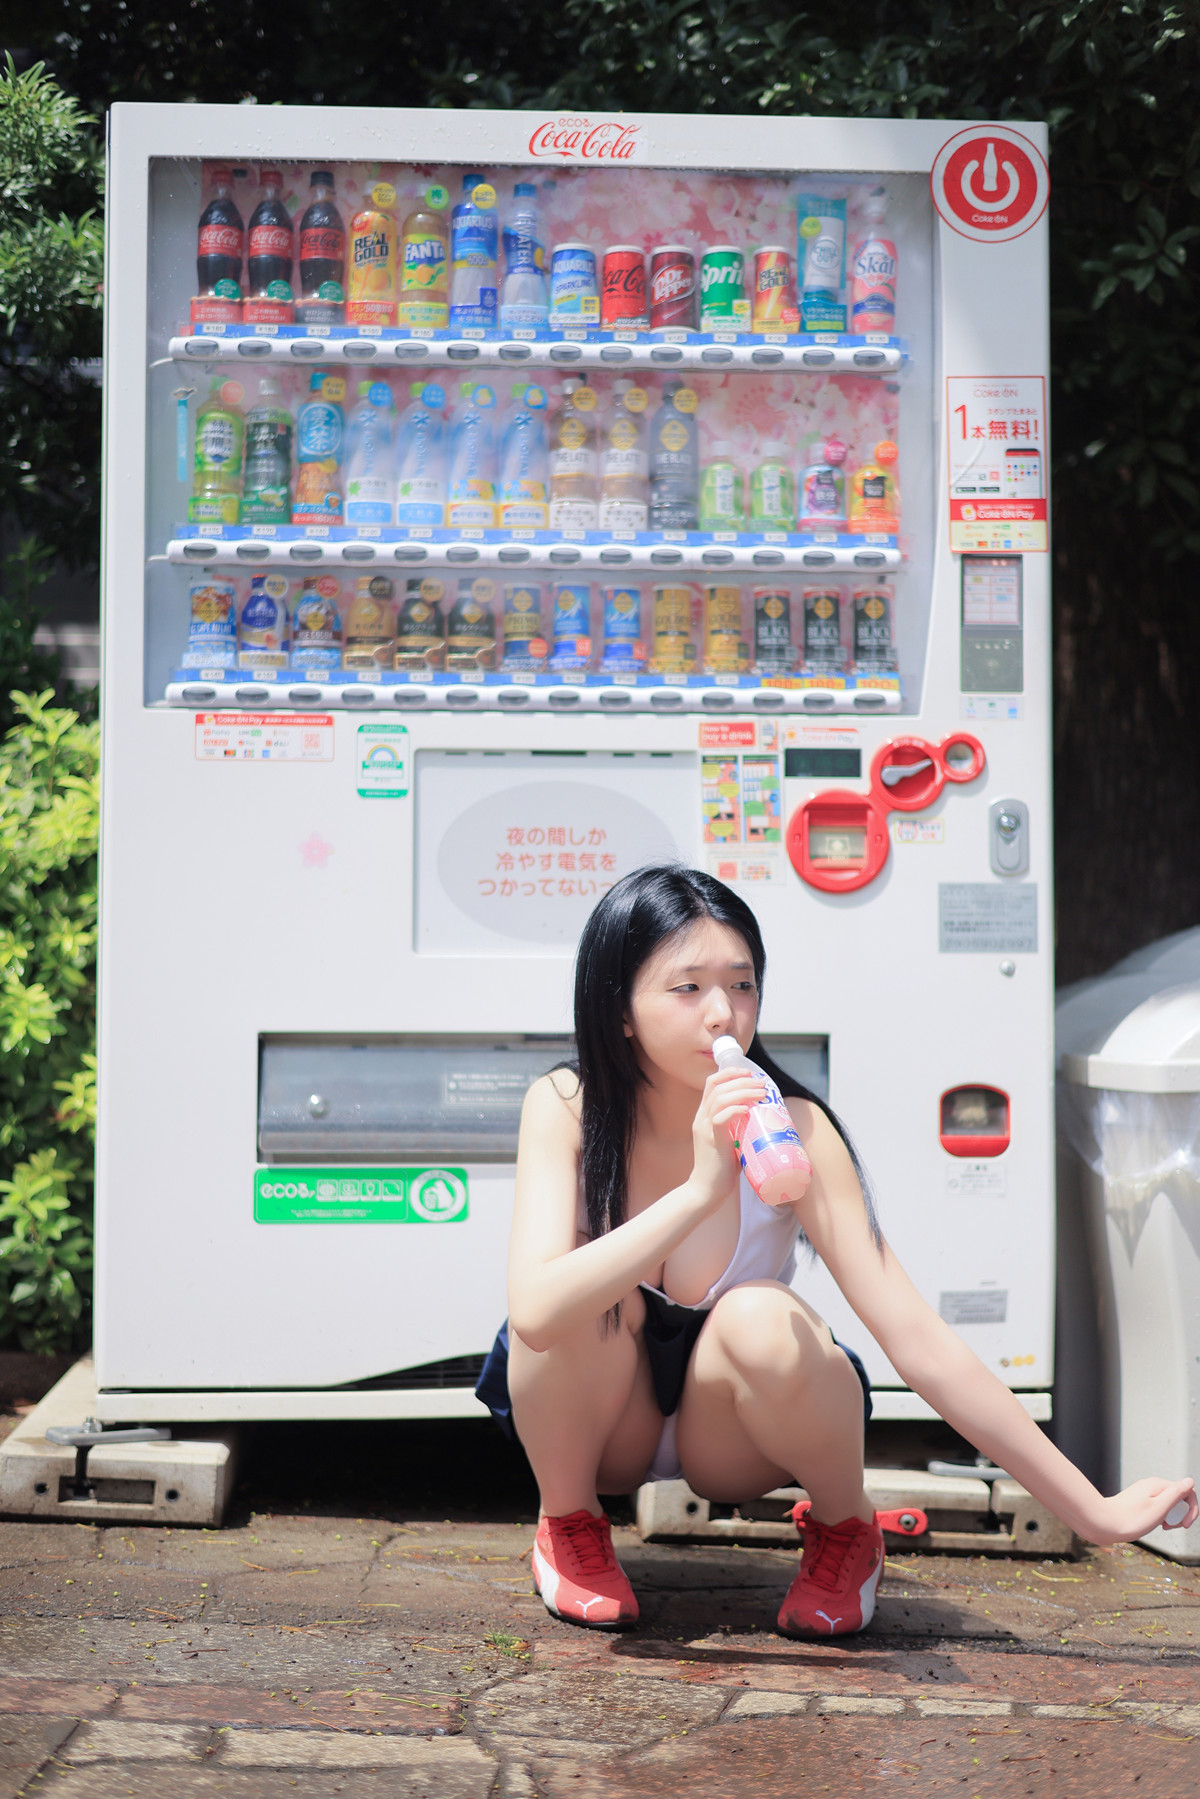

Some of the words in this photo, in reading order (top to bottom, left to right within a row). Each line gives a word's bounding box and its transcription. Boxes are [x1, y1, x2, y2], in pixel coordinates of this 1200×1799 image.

[529, 121, 642, 159] Coca-Cola
[972, 214, 994, 223] Coke
[995, 215, 1008, 223] ON
[200, 228, 240, 247] Coca-Cola
[250, 229, 289, 247] Coca-Cola
[302, 231, 341, 249] Coca-Cola
[354, 232, 387, 250] REAL
[354, 246, 389, 263] GOLD
[665, 269, 685, 281] Dr
[654, 277, 692, 301] Pepper
[973, 388, 1000, 397] Coke
[1002, 388, 1018, 397] ON
[954, 404, 1039, 441] 1本無料!
[1017, 510, 1035, 520] Pay
[249, 717, 264, 726] Pay
[719, 724, 729, 732] to
[702, 732, 719, 742] buy
[729, 732, 753, 741] drink
[507, 827, 607, 846] 夜の間しか
[496, 853, 617, 872] 冷やす電気を
[477, 878, 619, 897] つかってないっ
[758, 1087, 786, 1107] Sk
